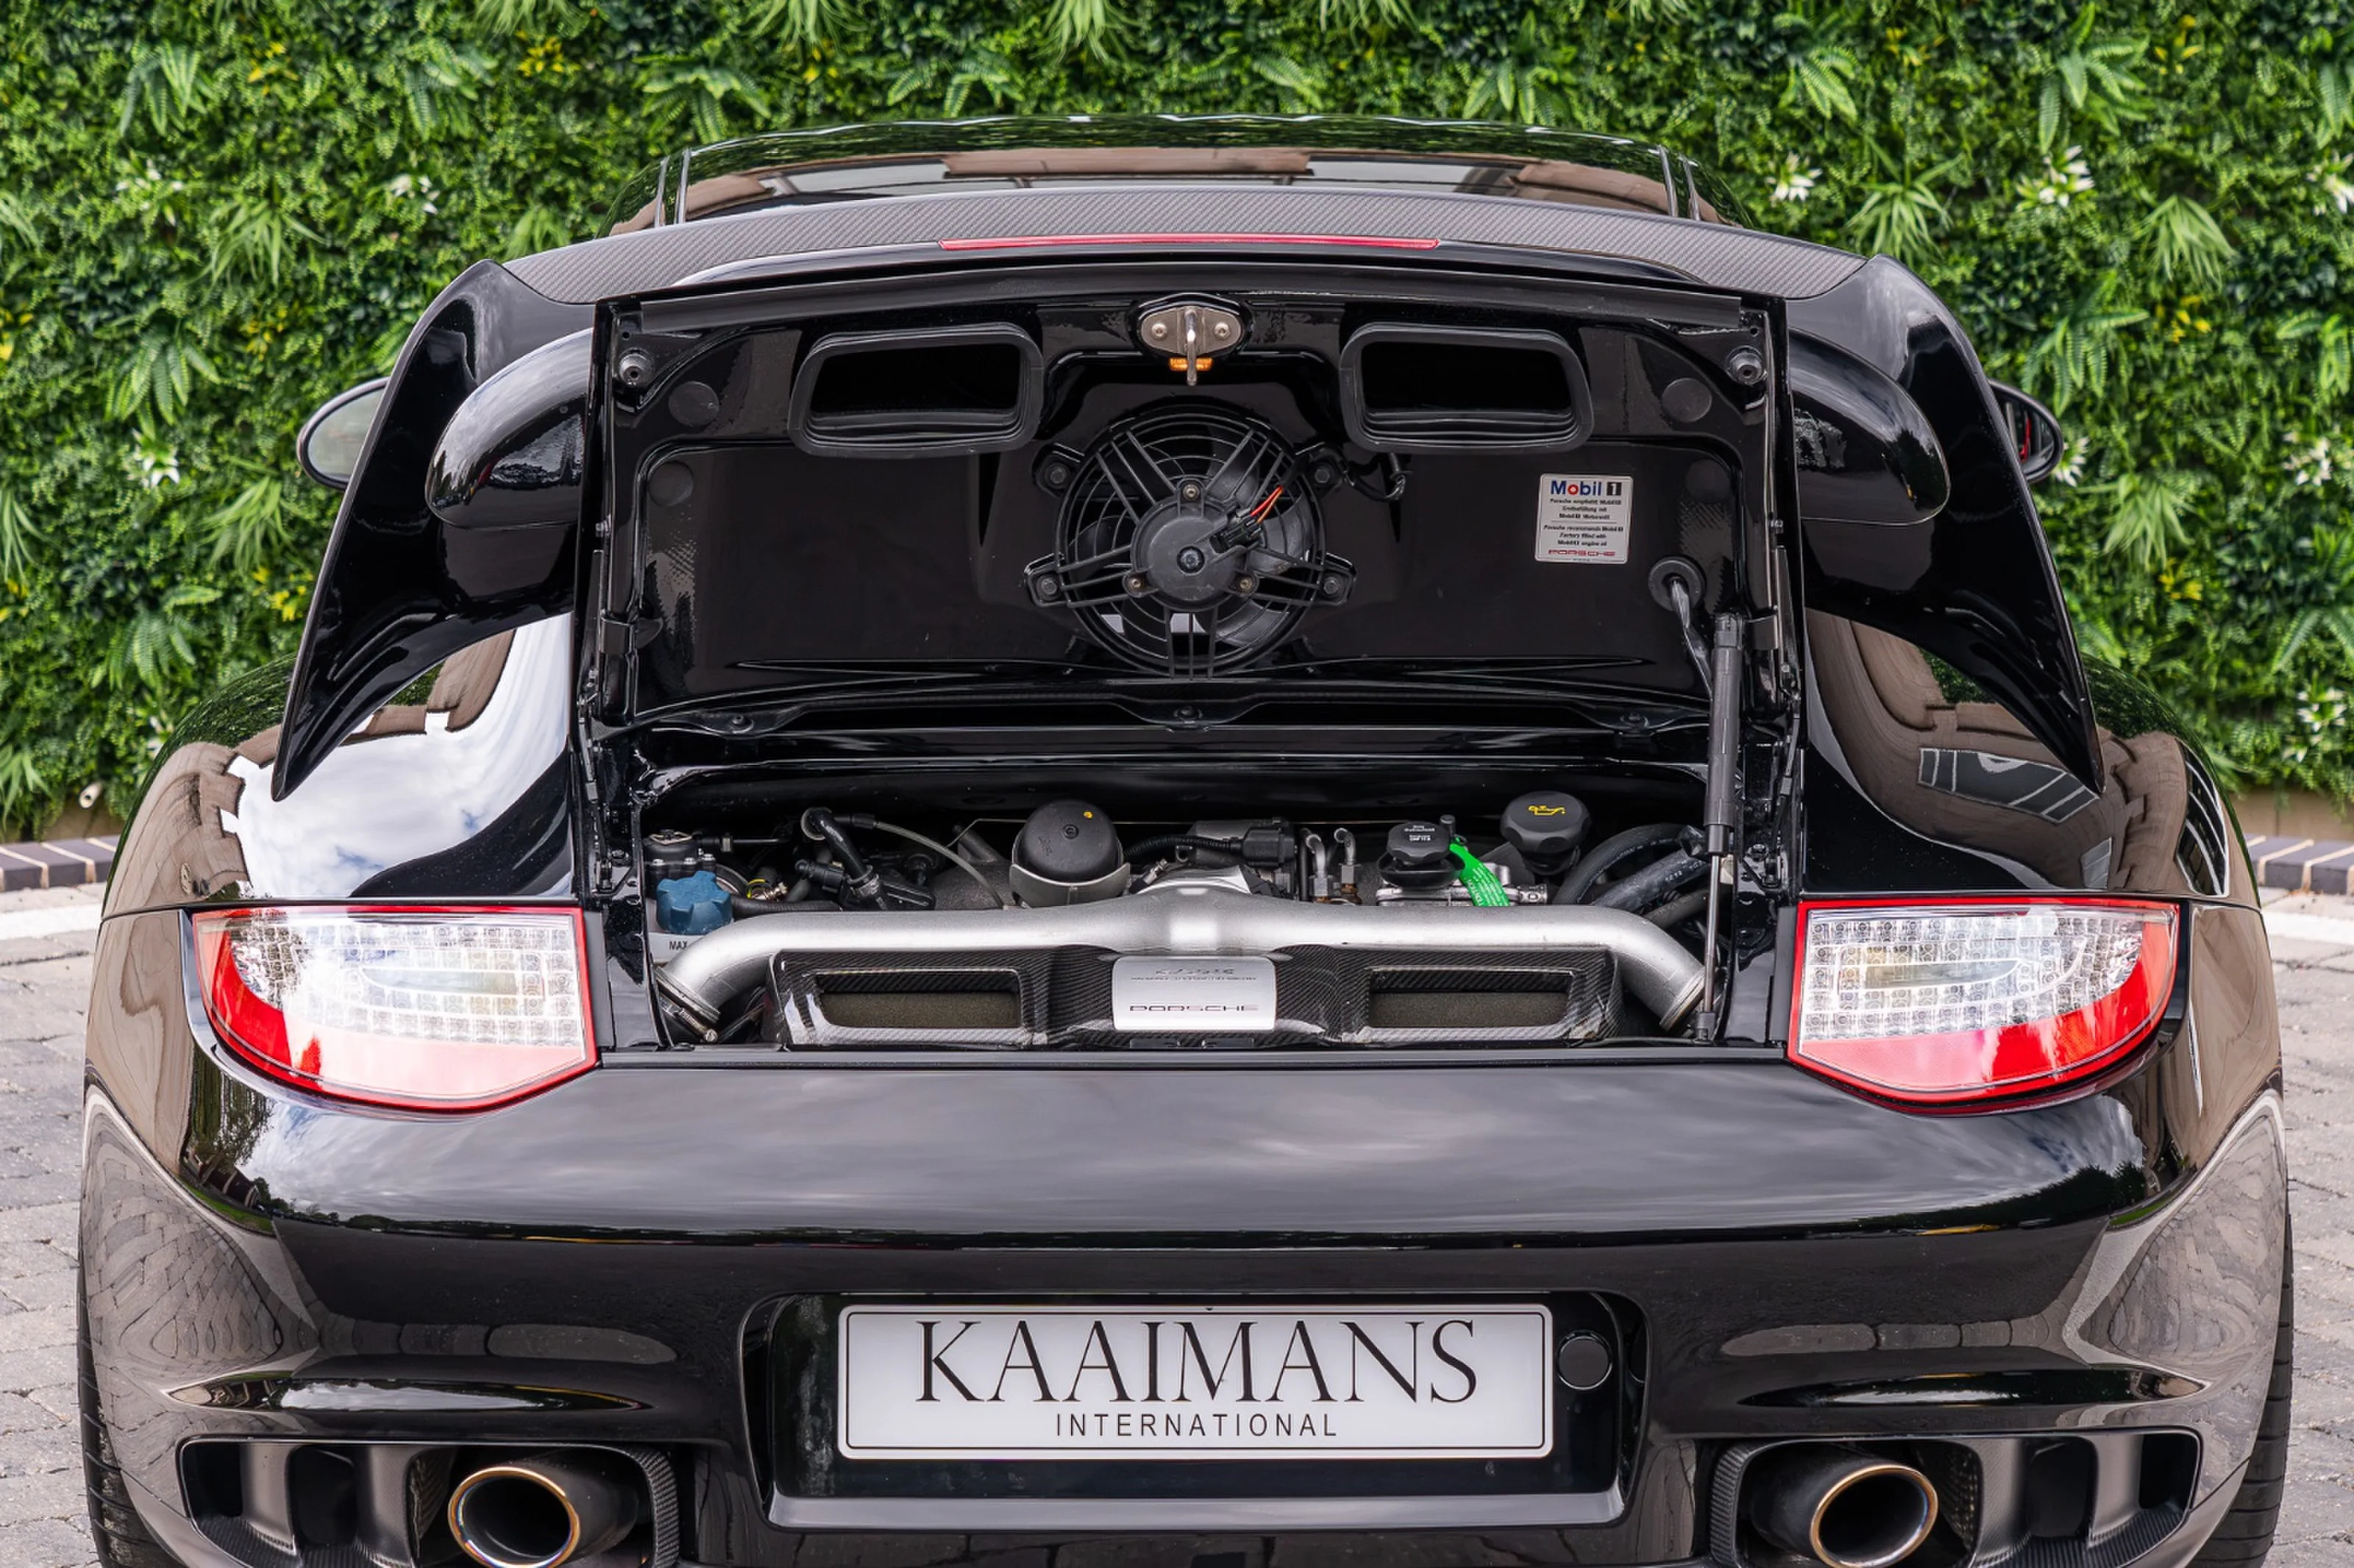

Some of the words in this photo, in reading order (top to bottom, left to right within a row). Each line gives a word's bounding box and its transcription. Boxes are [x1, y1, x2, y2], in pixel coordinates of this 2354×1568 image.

[1551, 480, 1602, 496] Mobil
[669, 941, 689, 950] MAX
[915, 1319, 1476, 1403] KAAIMANS
[1056, 1413, 1337, 1436] INTERNATIONAL
